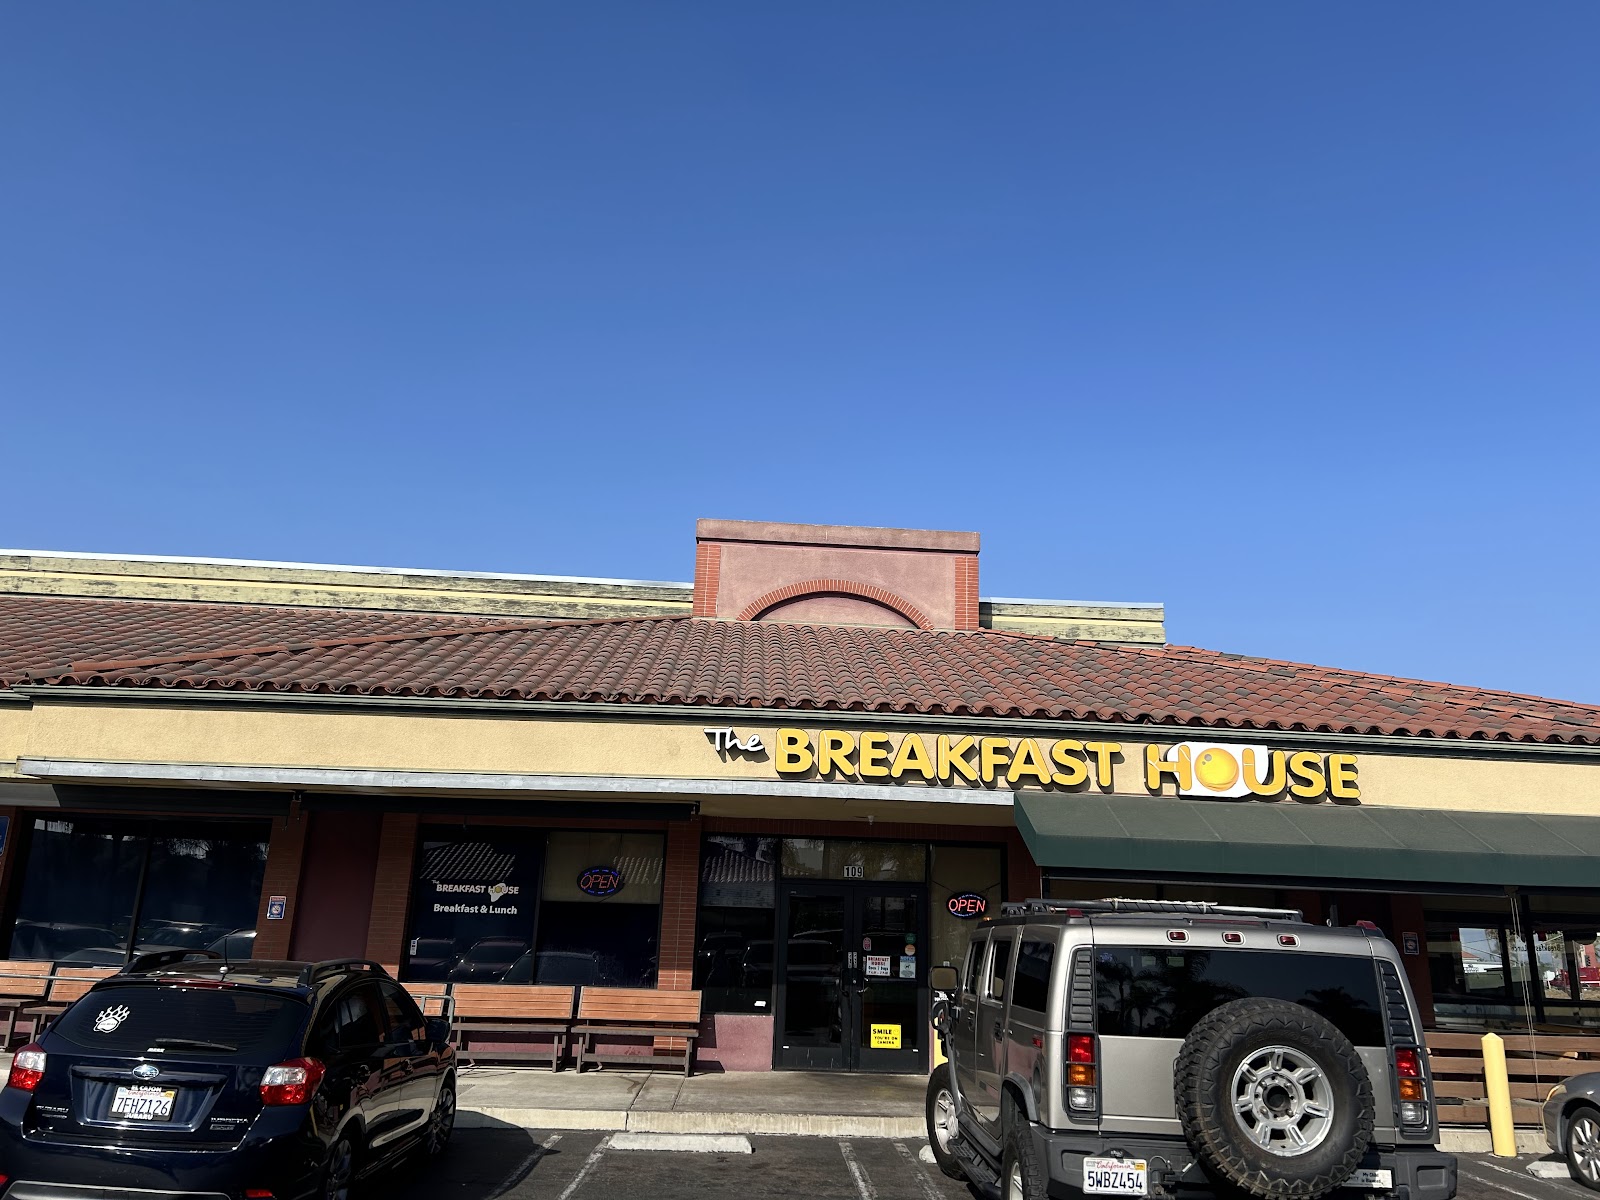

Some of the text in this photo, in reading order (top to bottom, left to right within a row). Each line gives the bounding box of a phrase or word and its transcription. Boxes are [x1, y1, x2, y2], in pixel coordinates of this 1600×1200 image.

[703, 726, 1361, 799] The BREAKFAST HOUSE
[846, 866, 863, 877] 109
[580, 874, 620, 889] OPEN
[436, 884, 486, 893] BREAKFAST
[488, 885, 519, 894] HOUSE
[433, 903, 517, 914] Breakfast & Lunch
[948, 898, 986, 912] OPEN
[117, 1098, 170, 1115] 7FHZ126
[1096, 1160, 1131, 1171] California
[1088, 1170, 1142, 1189] 5WBZ454
